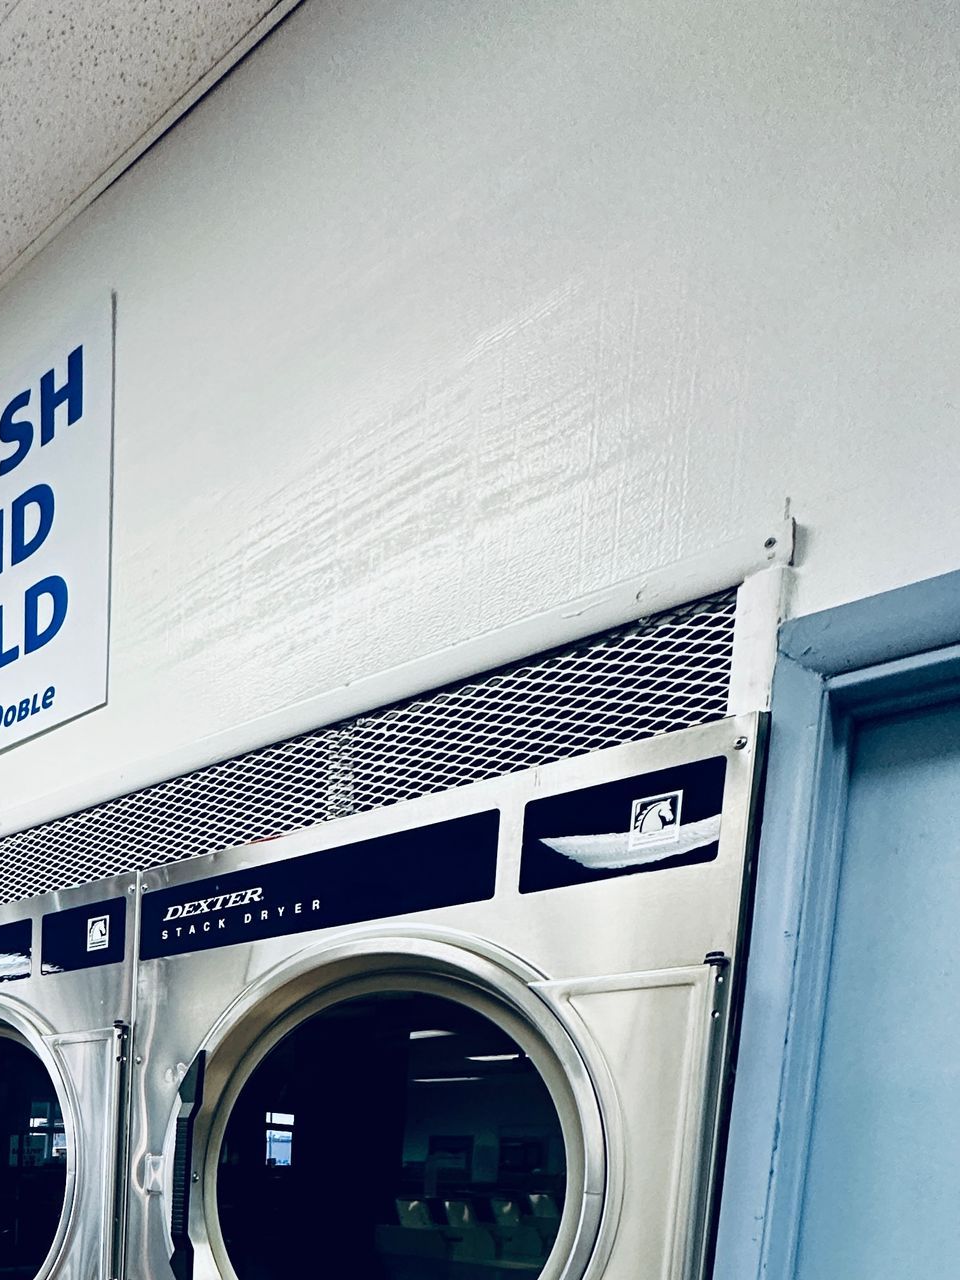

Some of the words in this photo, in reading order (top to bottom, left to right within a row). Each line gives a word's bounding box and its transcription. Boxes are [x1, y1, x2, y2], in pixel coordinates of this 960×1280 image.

[161, 918, 226, 940] STACK
[244, 899, 321, 925] DRYER
[162, 887, 264, 922] DEXTER
